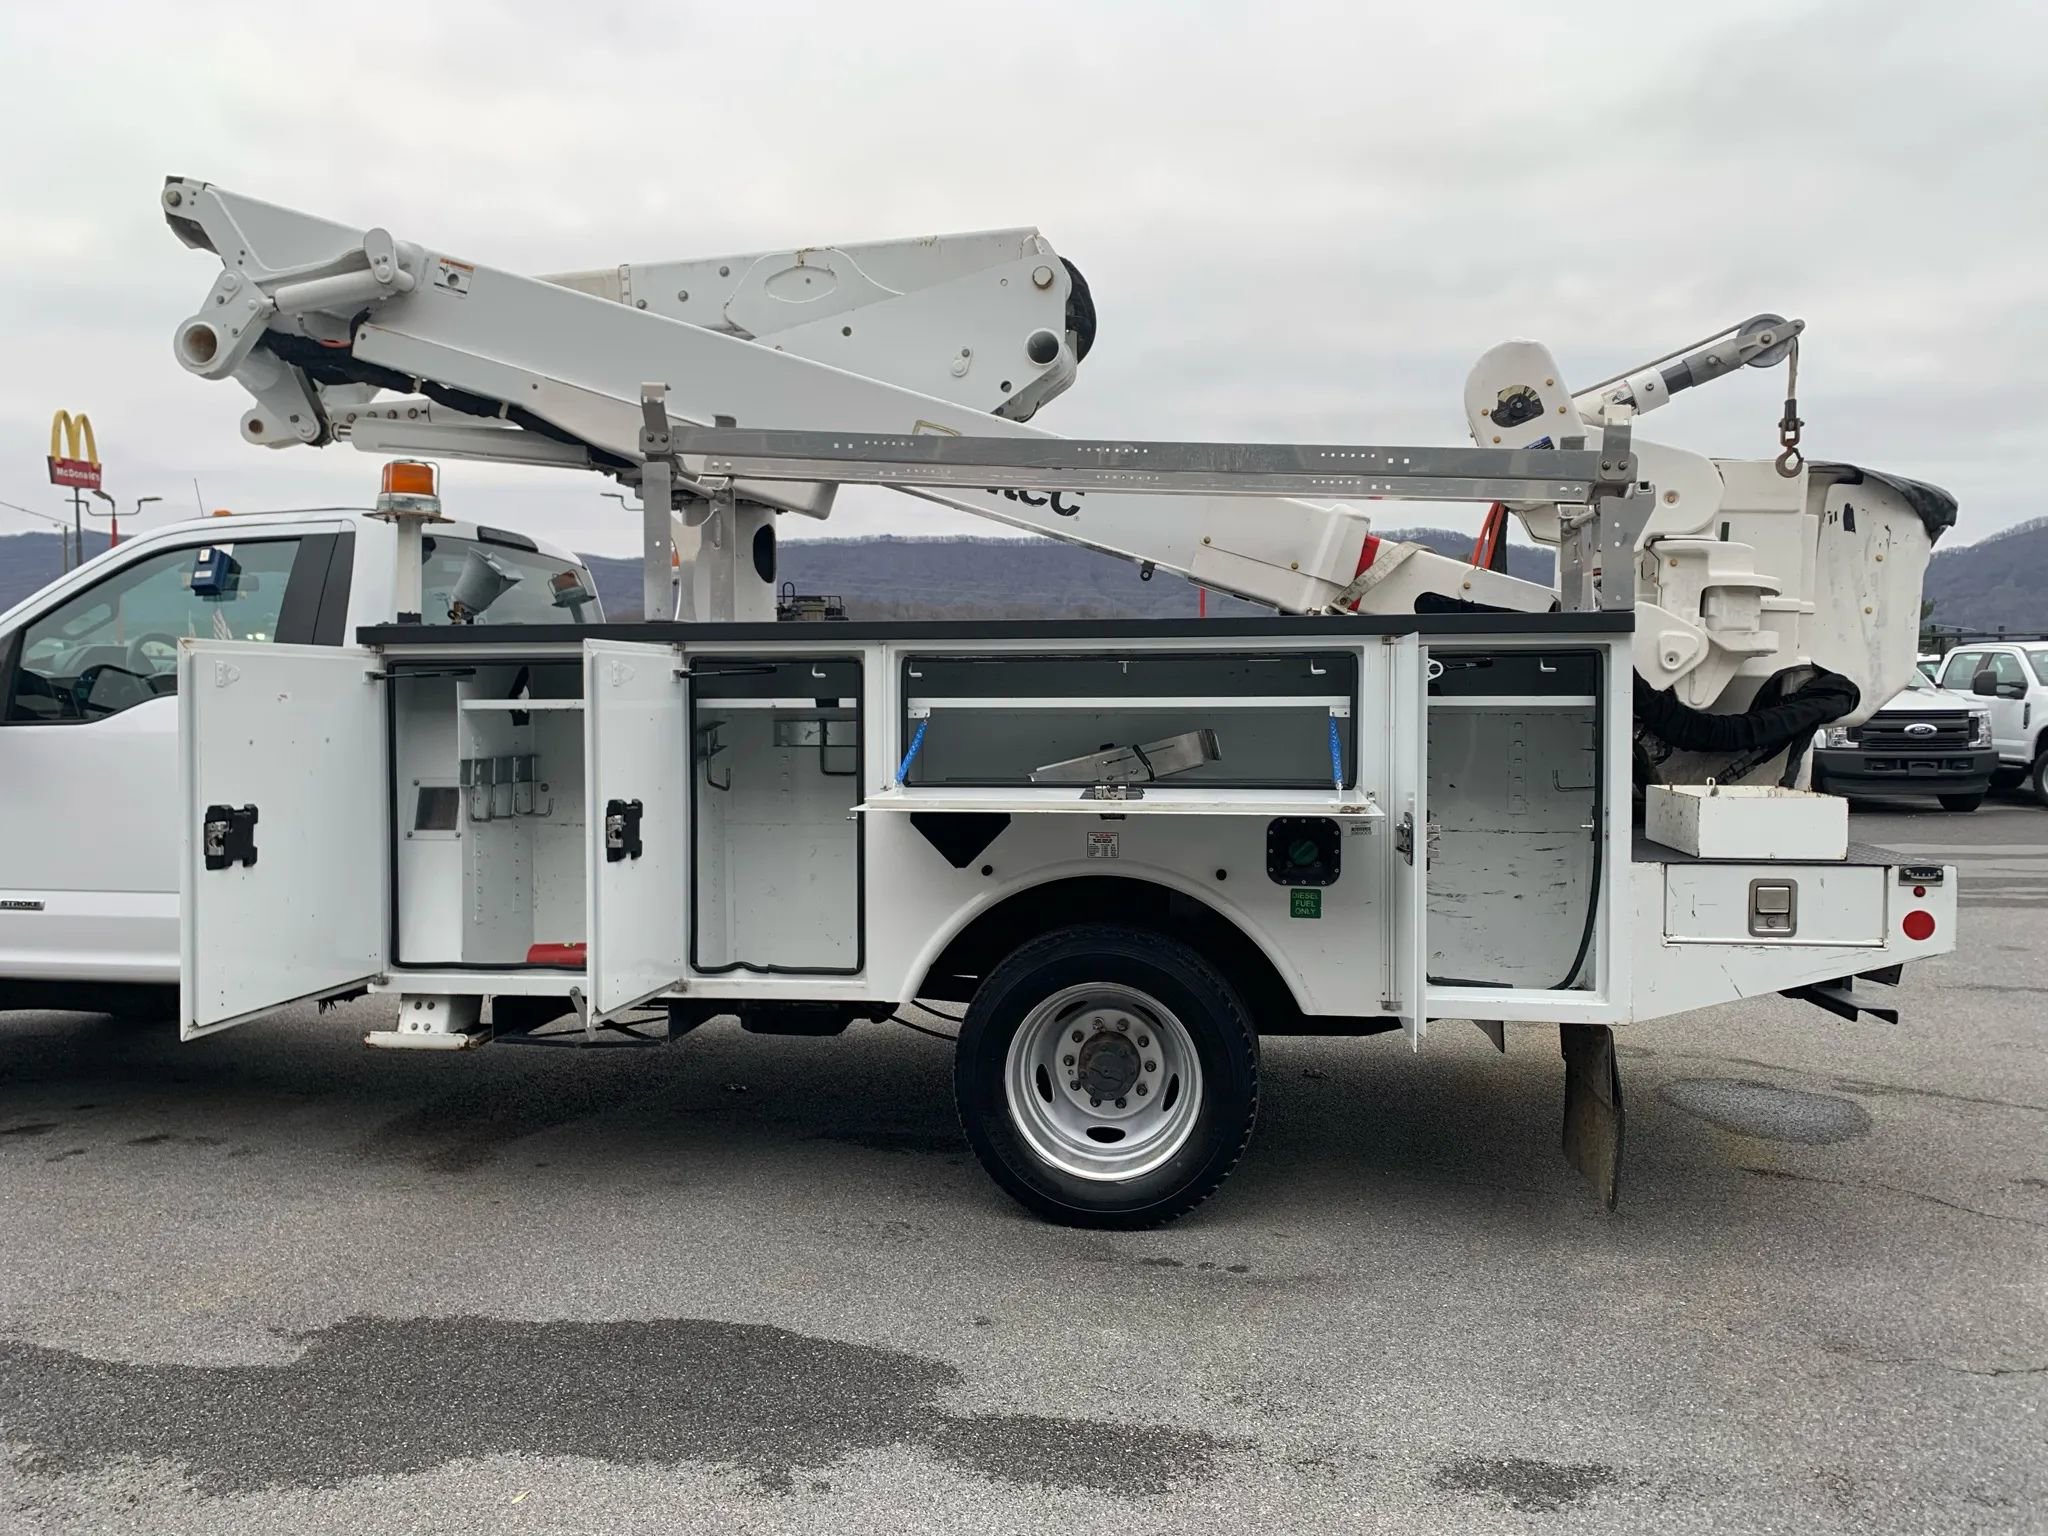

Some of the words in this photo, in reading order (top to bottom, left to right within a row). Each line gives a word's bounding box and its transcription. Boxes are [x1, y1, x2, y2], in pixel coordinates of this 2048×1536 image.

[1291, 891, 1319, 900] DIESEL
[0, 900, 41, 908] STROKE
[1295, 899, 1316, 908] FUEL
[1295, 907, 1316, 915] ONLY
